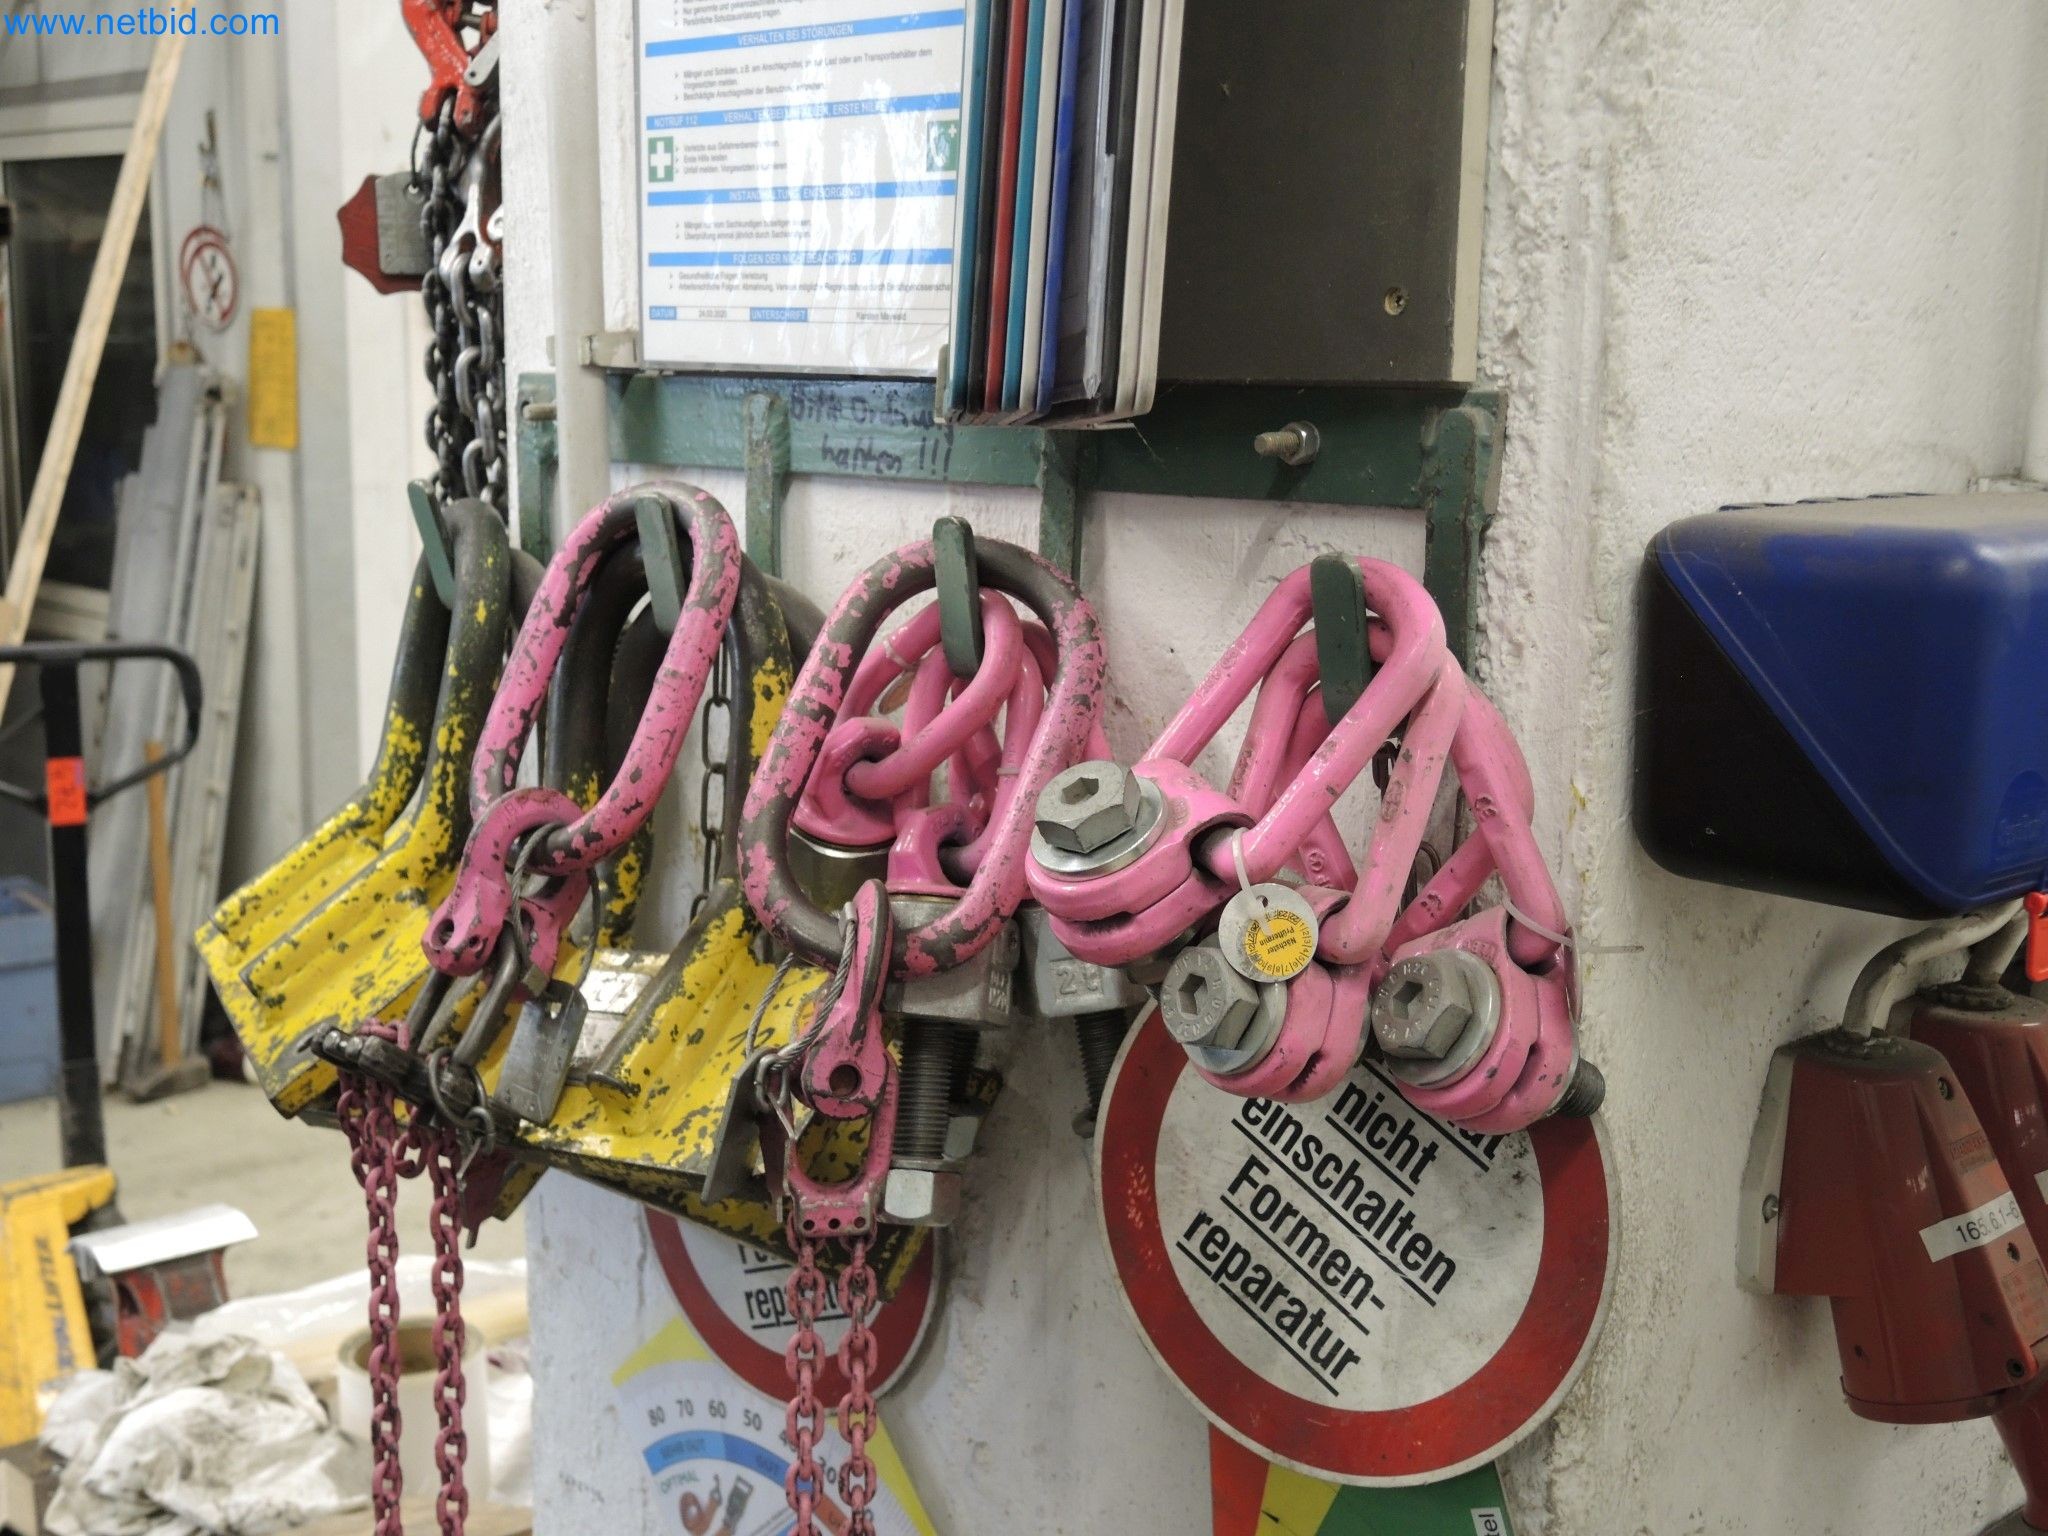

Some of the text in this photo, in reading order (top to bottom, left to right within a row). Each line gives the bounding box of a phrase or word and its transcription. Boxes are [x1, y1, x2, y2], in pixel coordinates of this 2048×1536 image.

[738, 31, 784, 47] VERHALTEN
[786, 29, 800, 41] BEI
[832, 102, 860, 115] ERSTE
[751, 308, 806, 321] UNTERSCHRIFT
[1266, 936, 1297, 954] Nächster
[1332, 1082, 1439, 1185] nicht
[1240, 1096, 1457, 1295] einschalten
[1227, 1153, 1385, 1312] Formen-
[1183, 1209, 1361, 1381] reparatur
[648, 1405, 665, 1427] 80
[676, 1399, 694, 1418] 70
[708, 1399, 727, 1419] 60
[743, 1408, 762, 1431] 50
